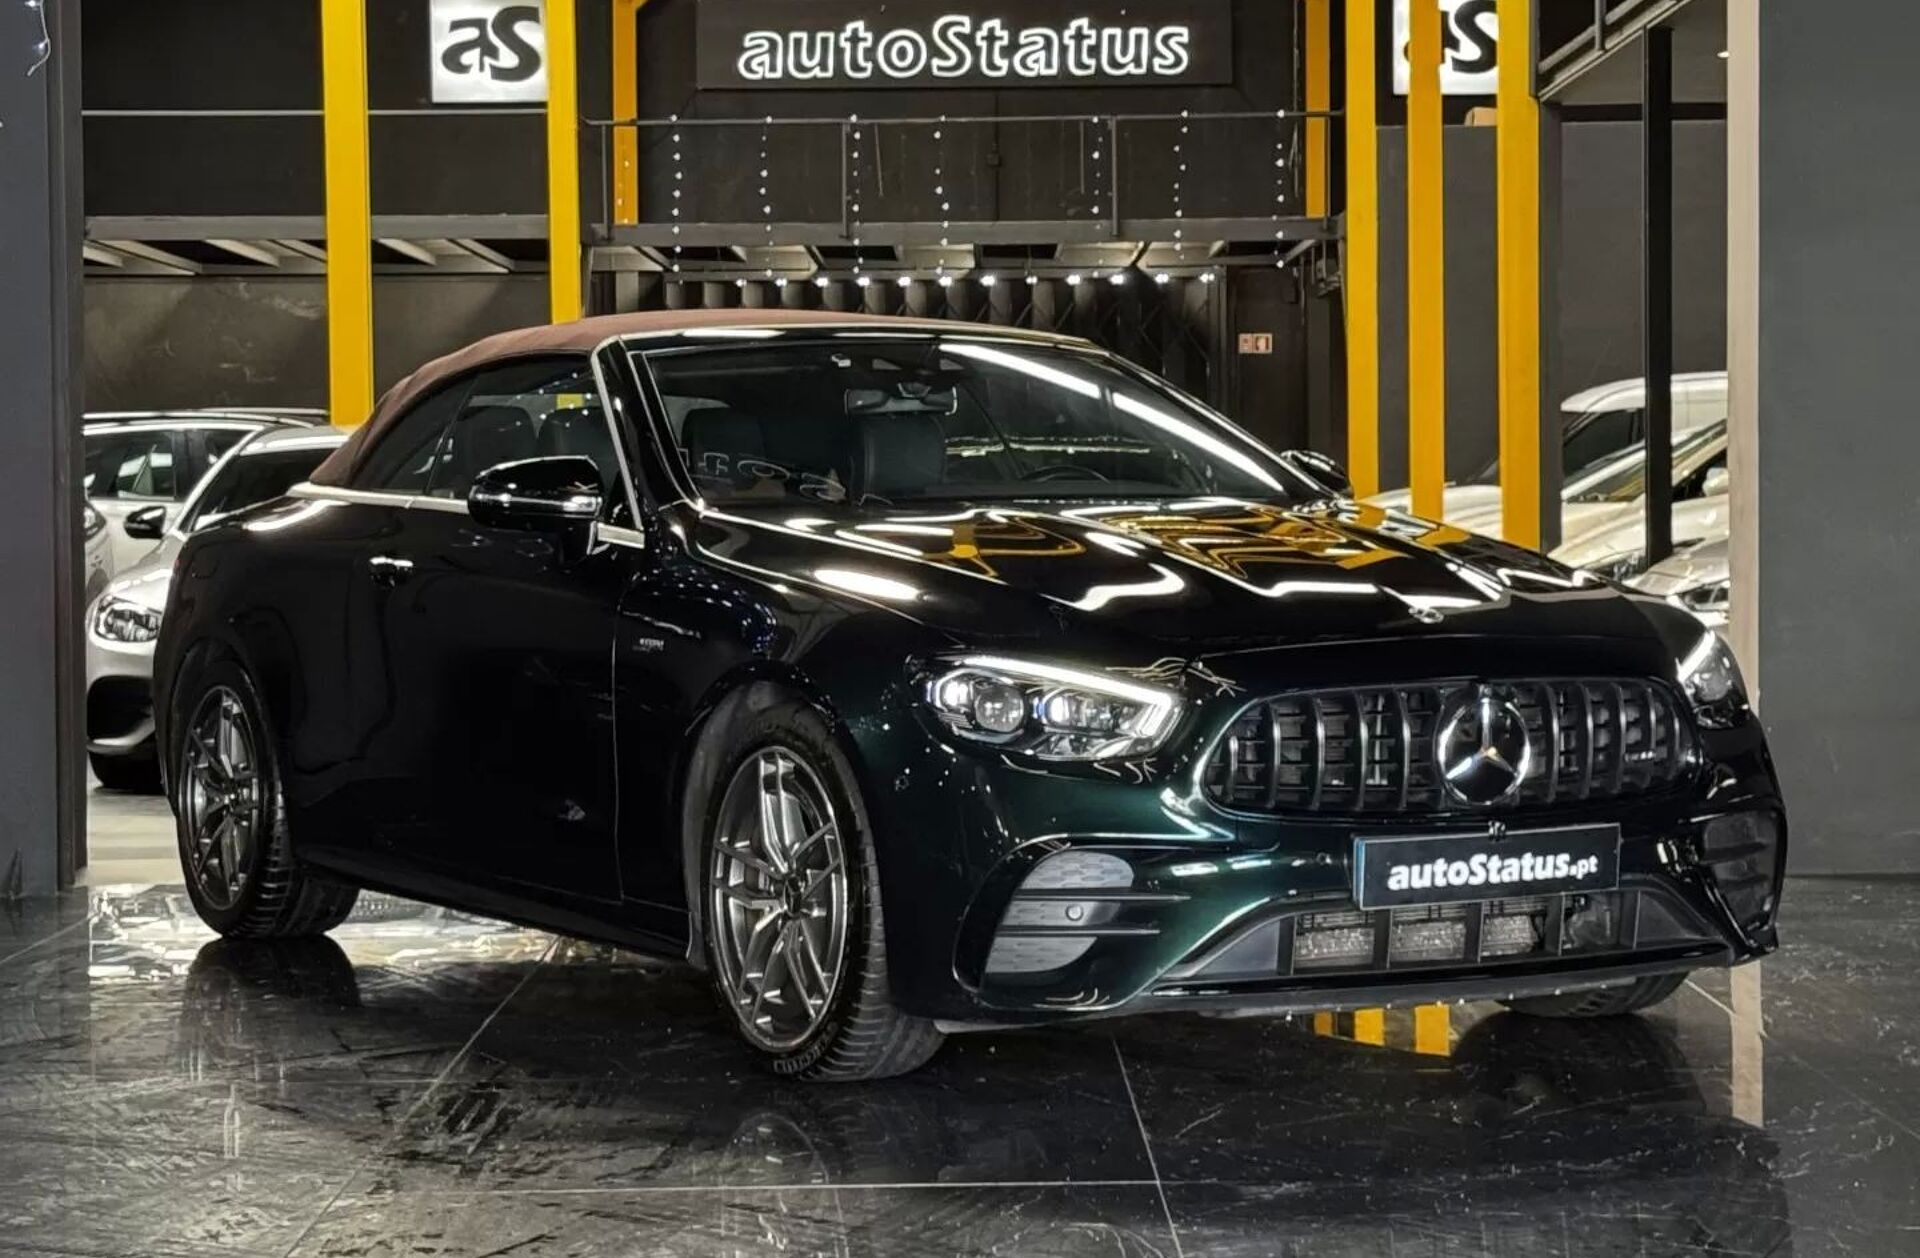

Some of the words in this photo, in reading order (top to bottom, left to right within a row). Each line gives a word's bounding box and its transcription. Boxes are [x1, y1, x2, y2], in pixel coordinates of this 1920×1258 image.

[737, 14, 1190, 79] autoStatus
[1403, 0, 1498, 75] S
[1387, 852, 1599, 891] autoStatus.pt
